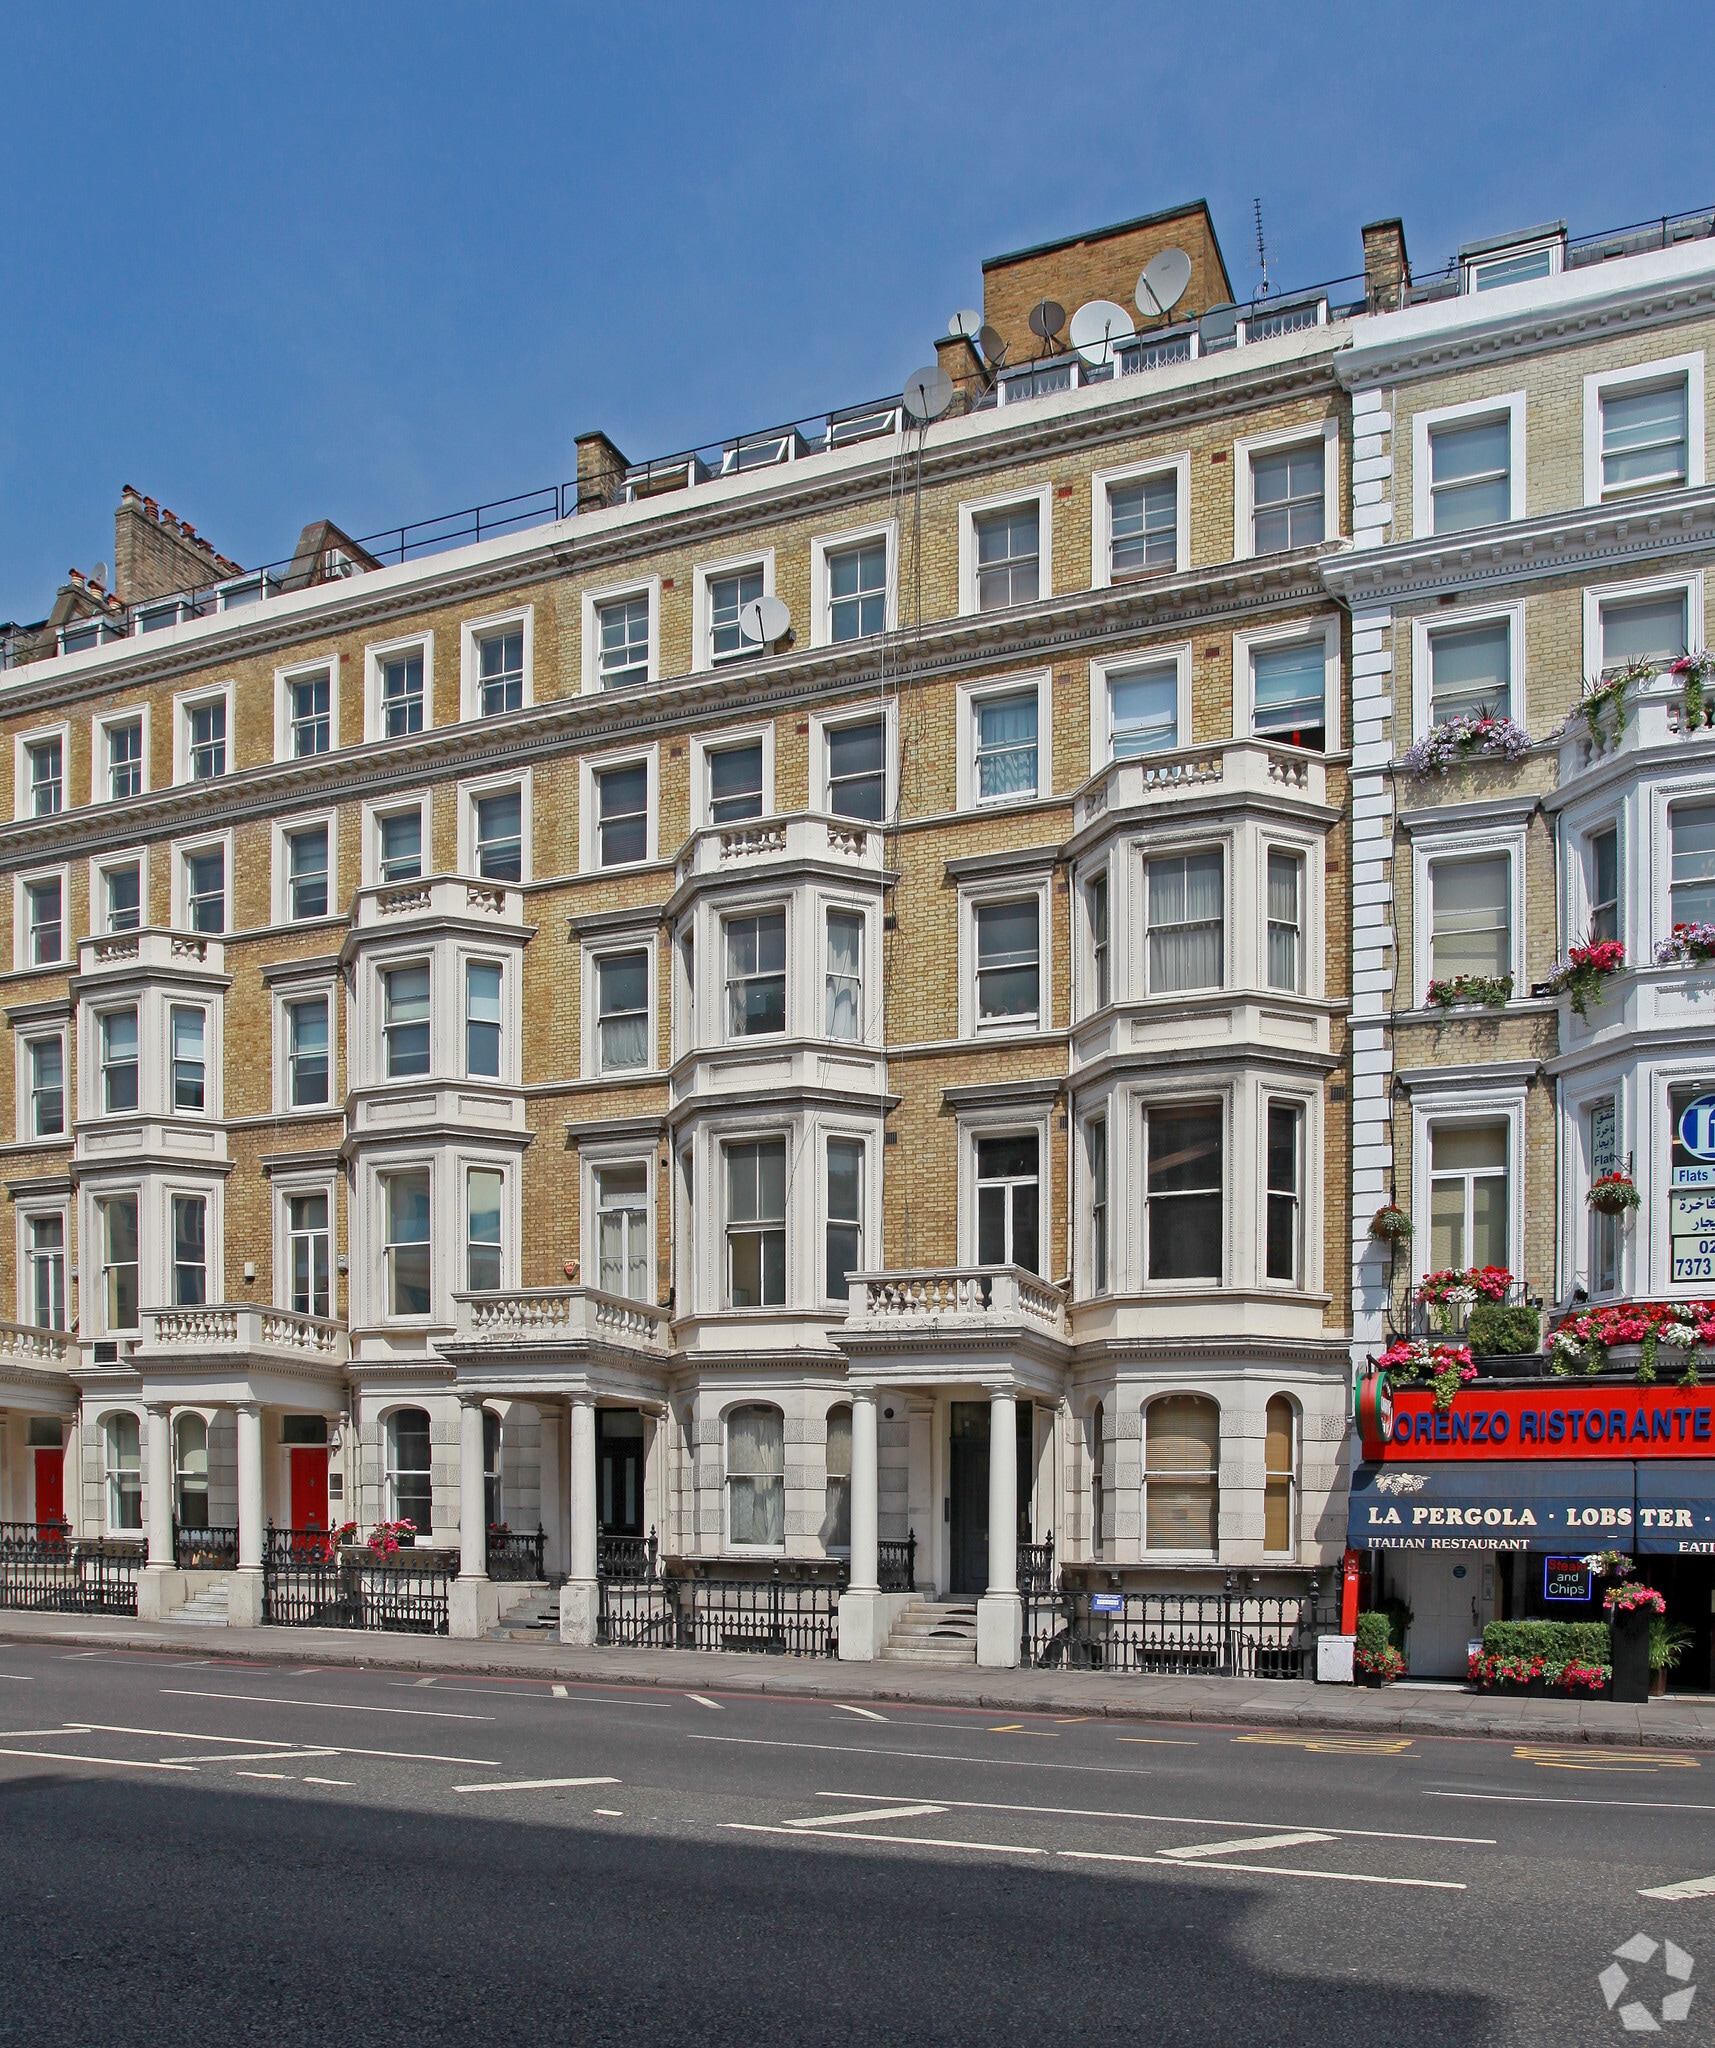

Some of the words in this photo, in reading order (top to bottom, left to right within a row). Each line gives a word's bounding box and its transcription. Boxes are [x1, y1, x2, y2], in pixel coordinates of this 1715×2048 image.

[1679, 1169, 1709, 1182] Flats
[1676, 1257, 1711, 1276] 7373
[1393, 1411, 1510, 1441] ORENZO
[1519, 1407, 1712, 1440] RISTORANTE
[1368, 1507, 1402, 1524] LA
[1411, 1507, 1538, 1526] PERGOLA
[1368, 1537, 1425, 1549] ITALIAN
[1431, 1538, 1530, 1550] RESTAURANT
[1556, 1573, 1579, 1582] and
[1548, 1583, 1585, 1597] Chips
